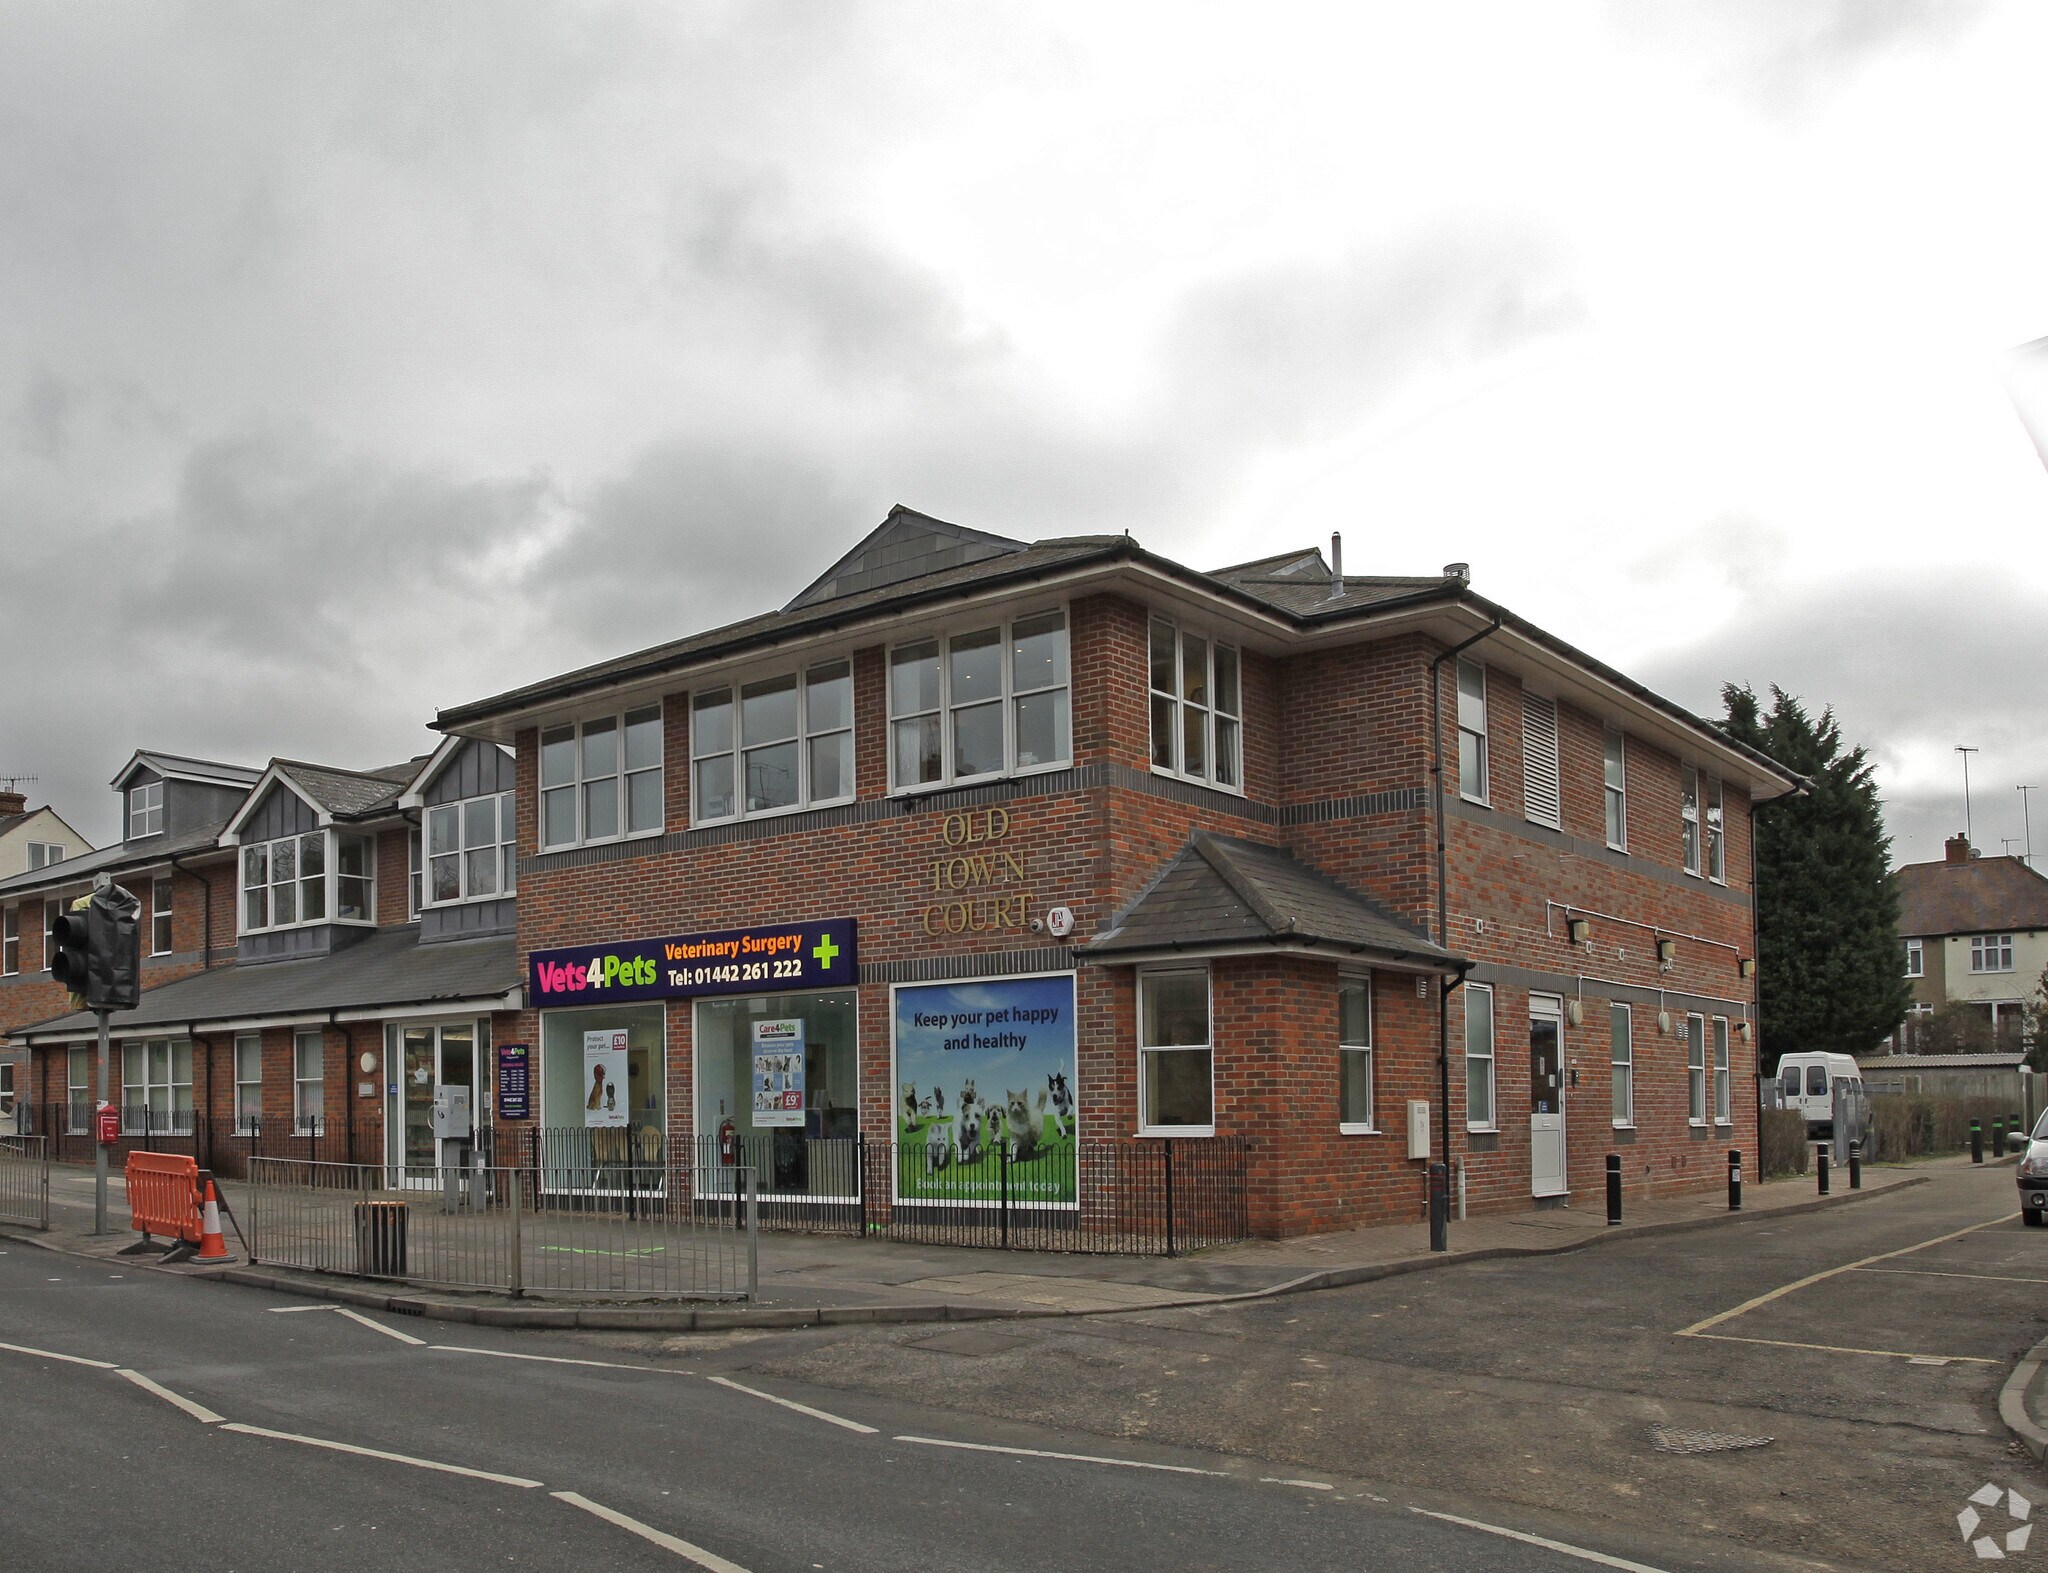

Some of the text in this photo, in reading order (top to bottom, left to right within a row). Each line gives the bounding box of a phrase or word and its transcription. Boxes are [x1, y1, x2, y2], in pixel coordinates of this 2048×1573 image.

[943, 808, 1009, 846] OLD
[928, 850, 1025, 892] TOWN
[923, 893, 1034, 936] COURT
[665, 935, 802, 960] Veterinary Surgery
[537, 955, 657, 993] Vets4Pets
[668, 959, 802, 986] Tel: 01442 261 222
[914, 1006, 1059, 1029] Keep your pet happy
[613, 1034, 626, 1045] £10
[944, 1032, 1027, 1051] and healthy
[916, 1177, 942, 1190] Book
